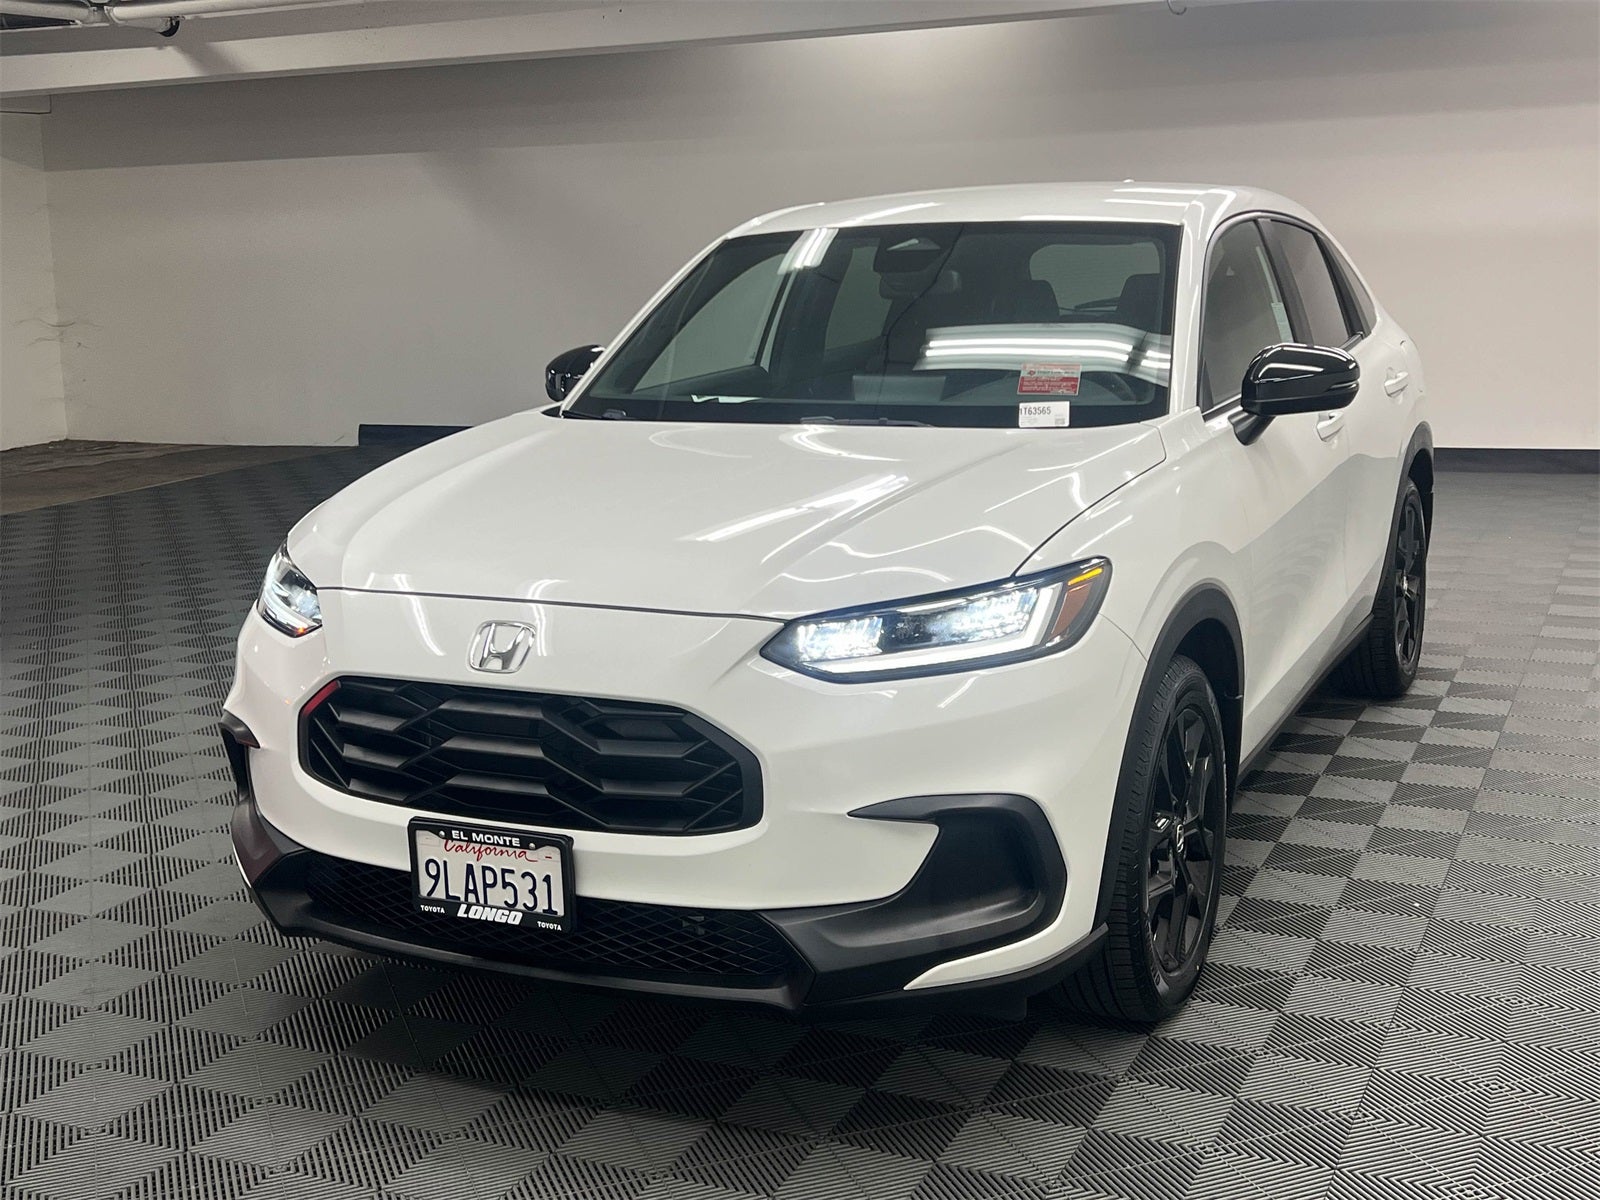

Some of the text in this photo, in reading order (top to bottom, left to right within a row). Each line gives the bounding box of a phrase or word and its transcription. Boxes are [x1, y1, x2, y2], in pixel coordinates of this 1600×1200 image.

[451, 830, 521, 847] EL MONTE
[443, 839, 538, 862] California
[424, 858, 558, 915] 9LAP531
[420, 904, 445, 914] TOYOTA
[457, 903, 523, 925] LONGO
[537, 921, 562, 931] TOYOTA
